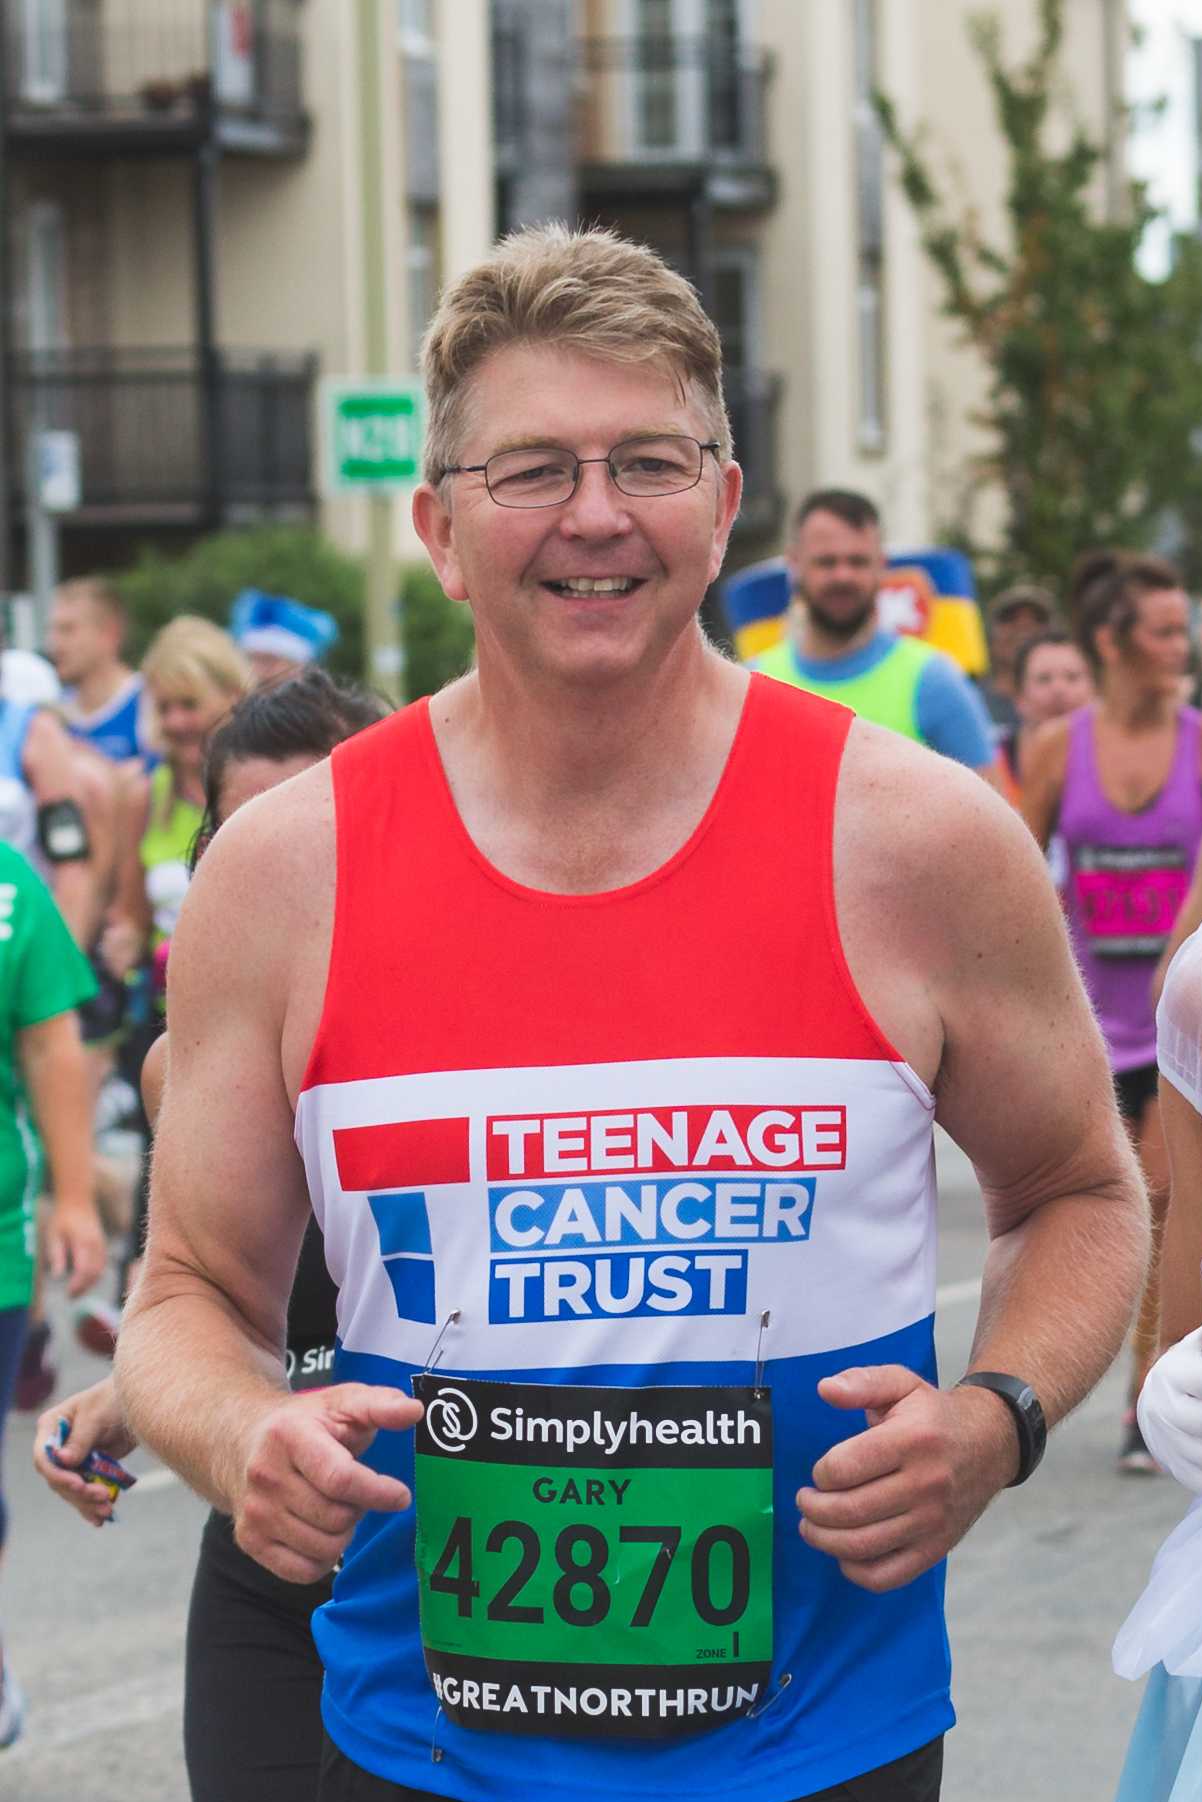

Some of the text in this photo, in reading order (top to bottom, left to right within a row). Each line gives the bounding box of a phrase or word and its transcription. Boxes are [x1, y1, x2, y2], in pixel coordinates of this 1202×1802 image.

[492, 1110, 843, 1175] TEENAGE
[494, 1183, 809, 1247] CANCER
[495, 1256, 742, 1317] TRUST
[490, 1408, 761, 1455] Simplyhealth
[532, 1477, 632, 1505] GARY
[429, 1516, 751, 1628] 42870
[696, 1648, 727, 1659] ZONE
